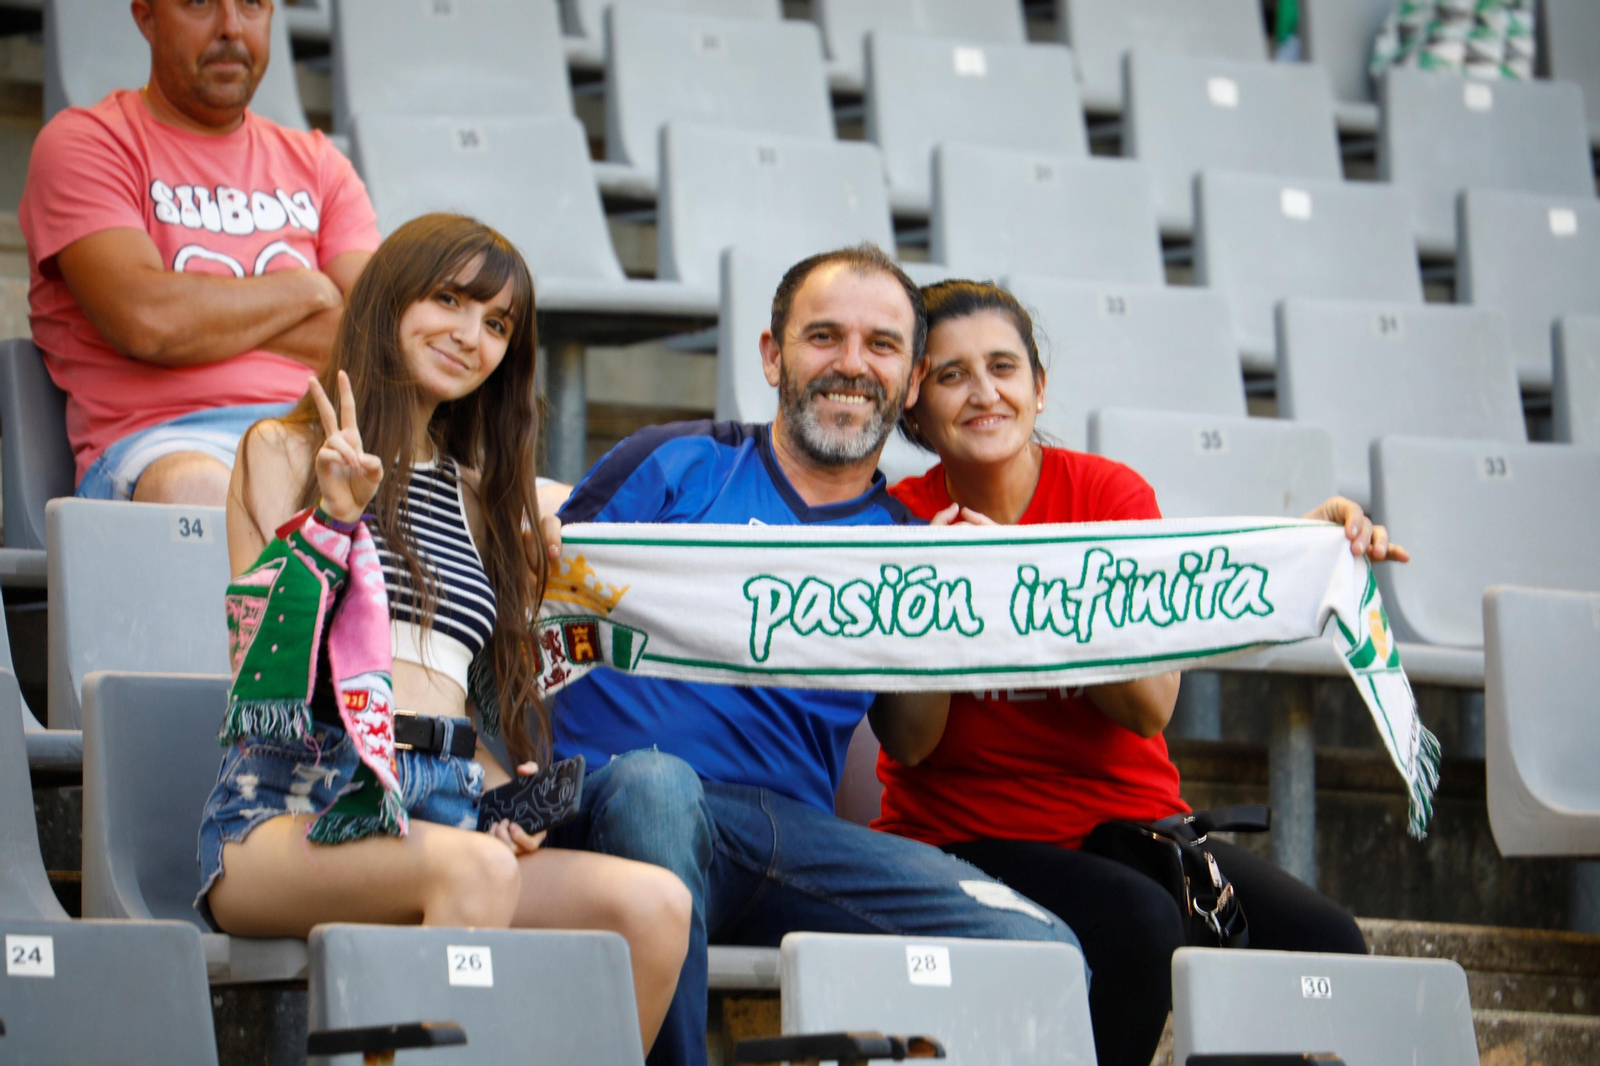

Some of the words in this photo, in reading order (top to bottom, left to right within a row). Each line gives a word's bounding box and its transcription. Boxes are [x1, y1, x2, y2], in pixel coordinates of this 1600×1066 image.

[150, 179, 319, 235] SILBON
[1200, 430, 1222, 450] 35
[1485, 456, 1507, 477] 33
[178, 516, 204, 538] 34
[743, 564, 984, 662] pasión
[1010, 546, 1274, 643] infinita
[12, 945, 43, 966] 24
[454, 953, 482, 972] 26
[912, 954, 937, 973] 28
[1303, 977, 1330, 998] 30
